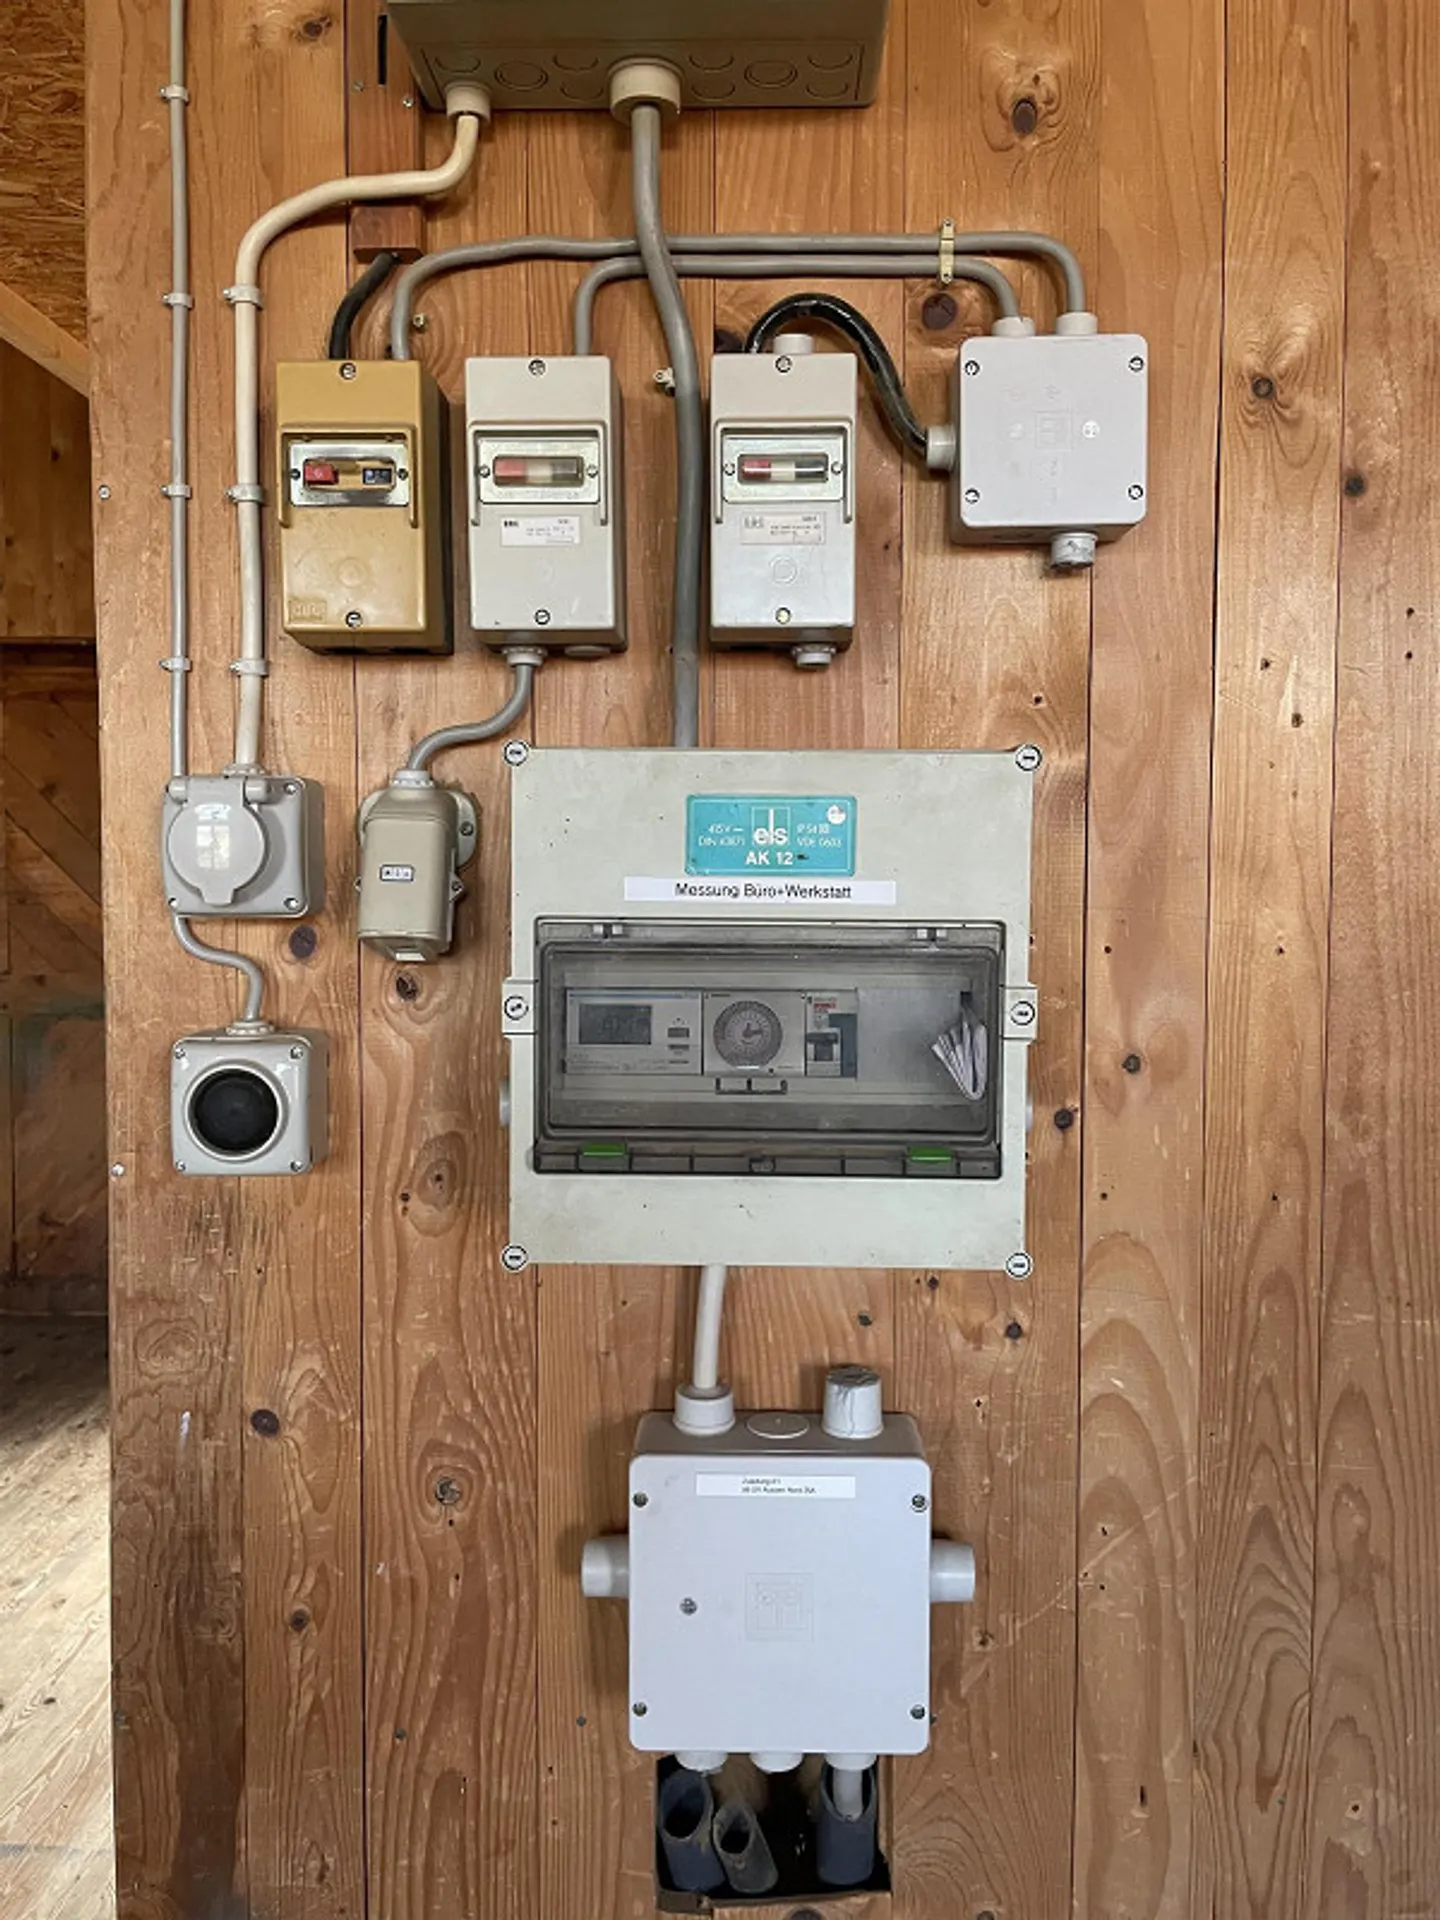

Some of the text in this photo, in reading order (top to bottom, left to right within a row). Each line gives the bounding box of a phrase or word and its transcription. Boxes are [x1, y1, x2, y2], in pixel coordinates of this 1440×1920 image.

[745, 851, 794, 865] AK 12
[674, 883, 740, 898] Messung
